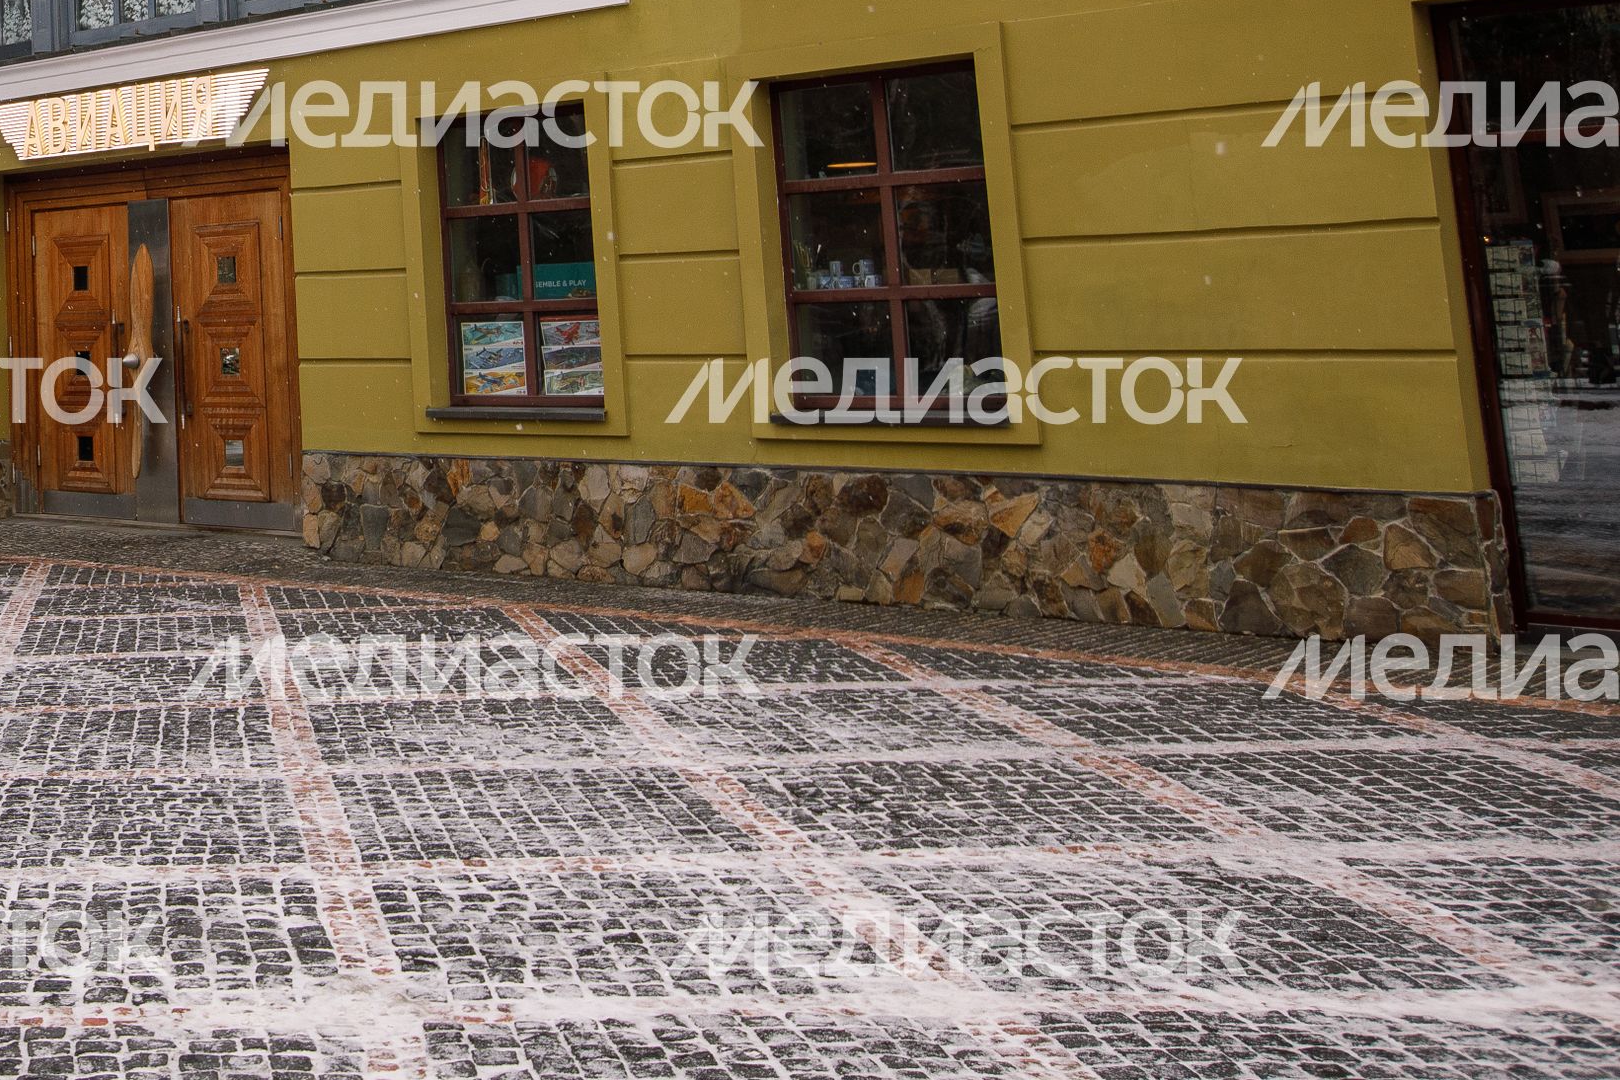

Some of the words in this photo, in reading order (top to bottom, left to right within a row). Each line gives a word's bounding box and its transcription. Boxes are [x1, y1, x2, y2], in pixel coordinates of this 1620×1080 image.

[22, 75, 213, 158] АВИАЦИЯ
[535, 280, 561, 288] SEMBLE
[569, 279, 587, 287] PLAY
